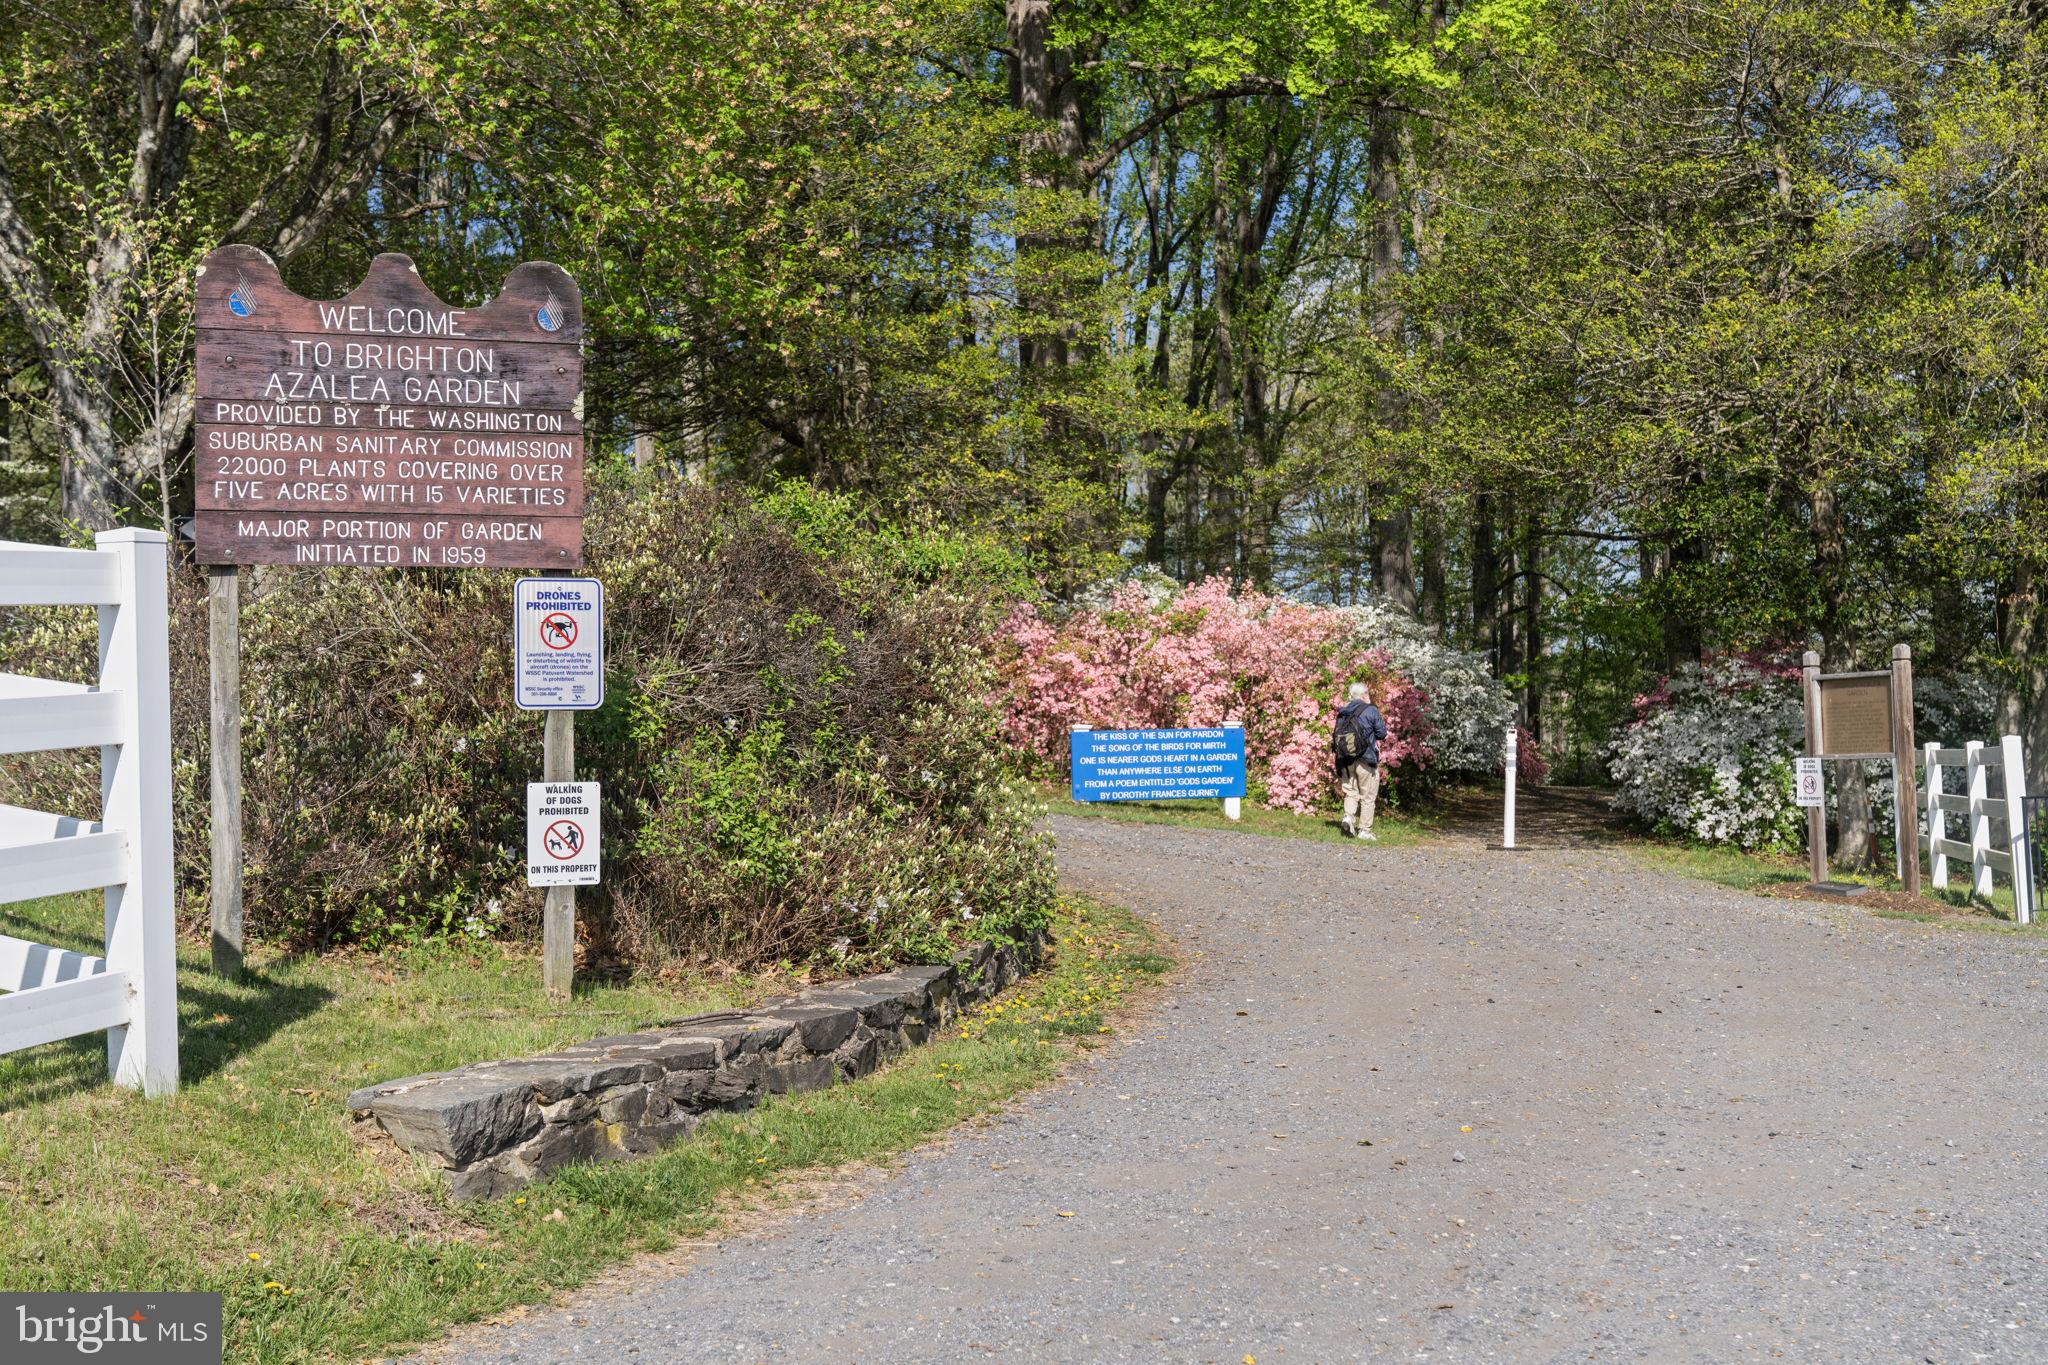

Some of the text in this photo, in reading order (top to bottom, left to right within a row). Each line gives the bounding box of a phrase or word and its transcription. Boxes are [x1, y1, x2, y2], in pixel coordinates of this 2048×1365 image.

[319, 304, 466, 336] WELCOME
[292, 340, 493, 372] TO BRIGHTON
[265, 373, 520, 404] AZALEA GARDEN
[217, 404, 562, 431] PROVIDED BY THE WASHINGTON
[209, 432, 572, 458] SUBURBAN SANITARY COMMISSION
[218, 458, 563, 481] 22000 PLANTS COVERING OVER
[215, 482, 565, 505] FIVE ACRES WITH 15 VARIETIES
[238, 520, 542, 540] MAJOR PORTION OF GARDEN
[297, 545, 486, 564] INITIATED IN 1959
[537, 592, 580, 600] DRONES
[527, 602, 591, 611] PROHIBITED
[1094, 733, 1108, 741] THE
[1110, 732, 1127, 740] KISS
[1129, 732, 1140, 740] OF
[1109, 744, 1131, 752] SONG
[1108, 756, 1138, 764] NEARER
[1140, 755, 1162, 763] GODS
[1191, 754, 1198, 762] IN
[1207, 753, 1237, 761] GARDEN
[1097, 768, 1118, 776] THAN
[1120, 767, 1162, 775] ANYWHERE
[1085, 780, 1107, 788] FROM
[1116, 779, 1138, 787] POEM
[1140, 778, 1175, 786] ENTITLED
[1112, 791, 1149, 799] DOROTHY
[1151, 790, 1186, 798] FRANCES
[1188, 789, 1219, 797] GURNEY
[539, 807, 588, 815] PROHIBITED
[531, 866, 540, 874] ON
[561, 864, 597, 872] PROPERTY
